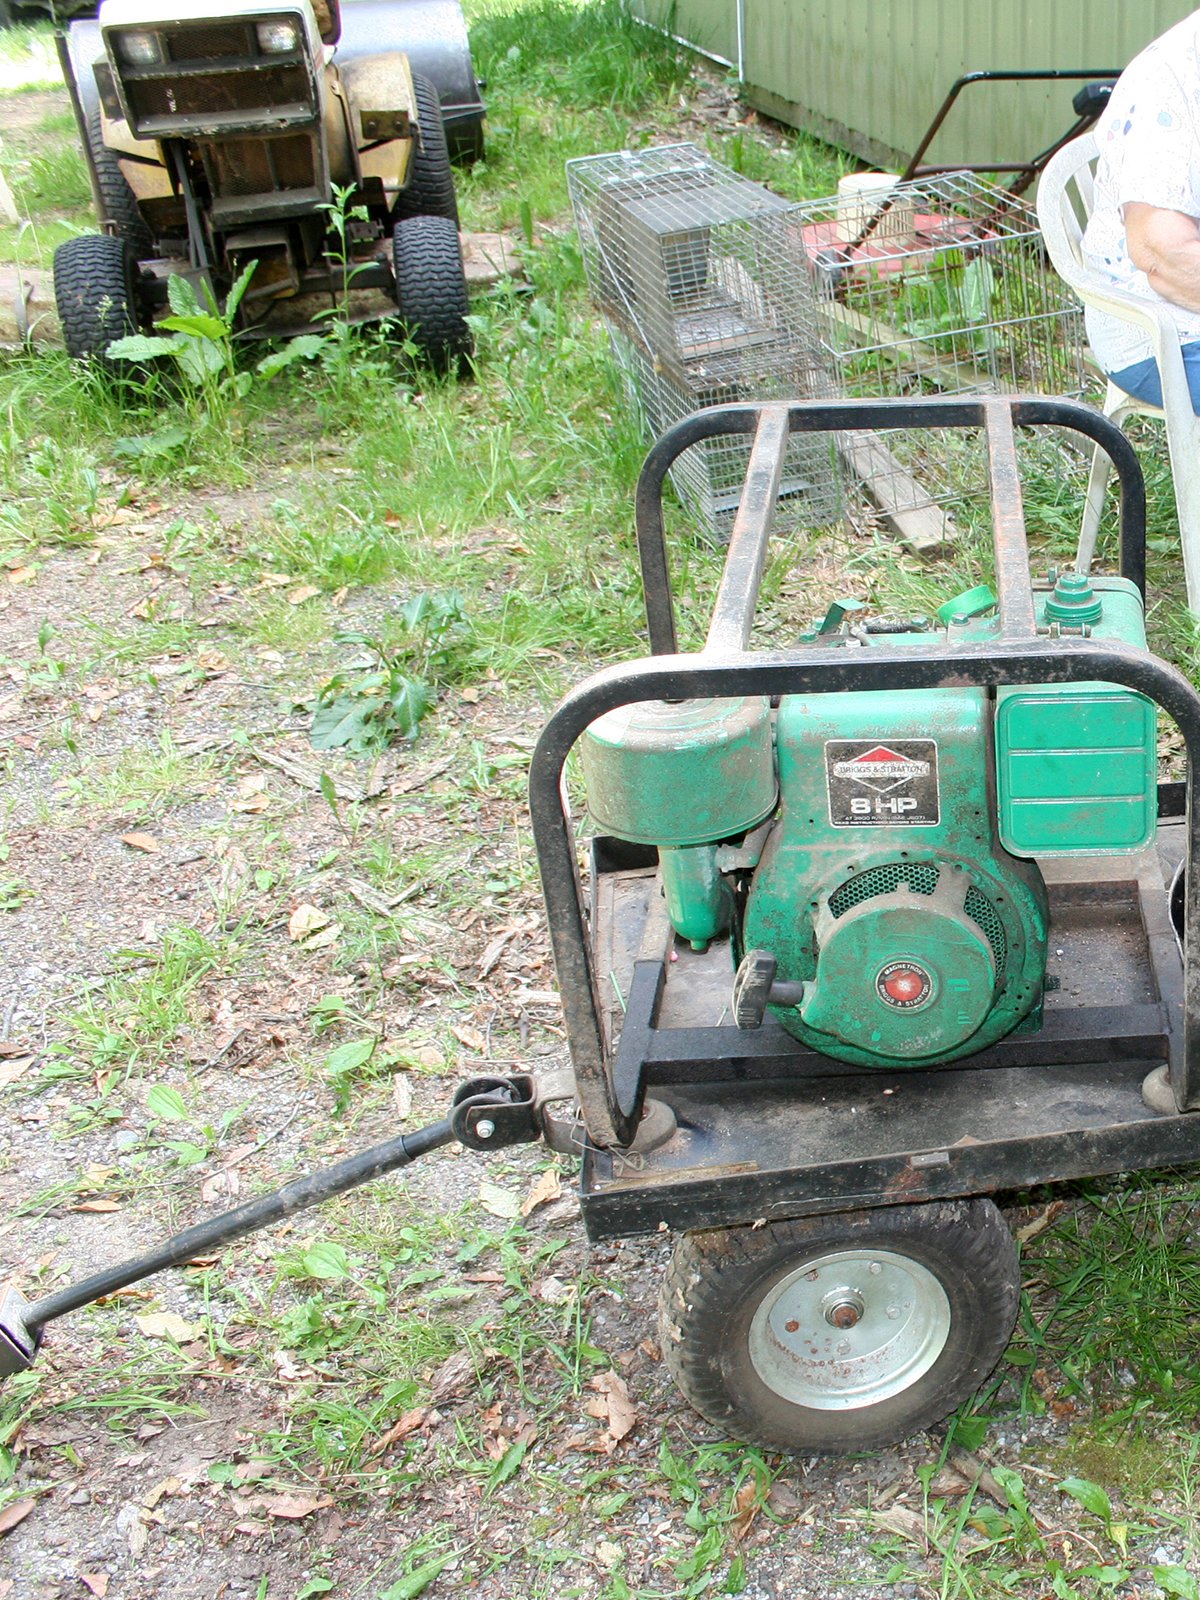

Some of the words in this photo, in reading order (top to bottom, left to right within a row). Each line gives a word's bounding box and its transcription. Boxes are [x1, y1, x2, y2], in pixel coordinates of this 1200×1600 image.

[839, 765, 872, 774] BRIGGS
[873, 765, 880, 773] &
[880, 765, 923, 774] STRATTON
[850, 797, 871, 814] 8
[875, 797, 918, 814] HP
[884, 963, 923, 975] MAGNETRON
[878, 984, 896, 1004] BRIGGS
[905, 984, 930, 1007] STRATTON
